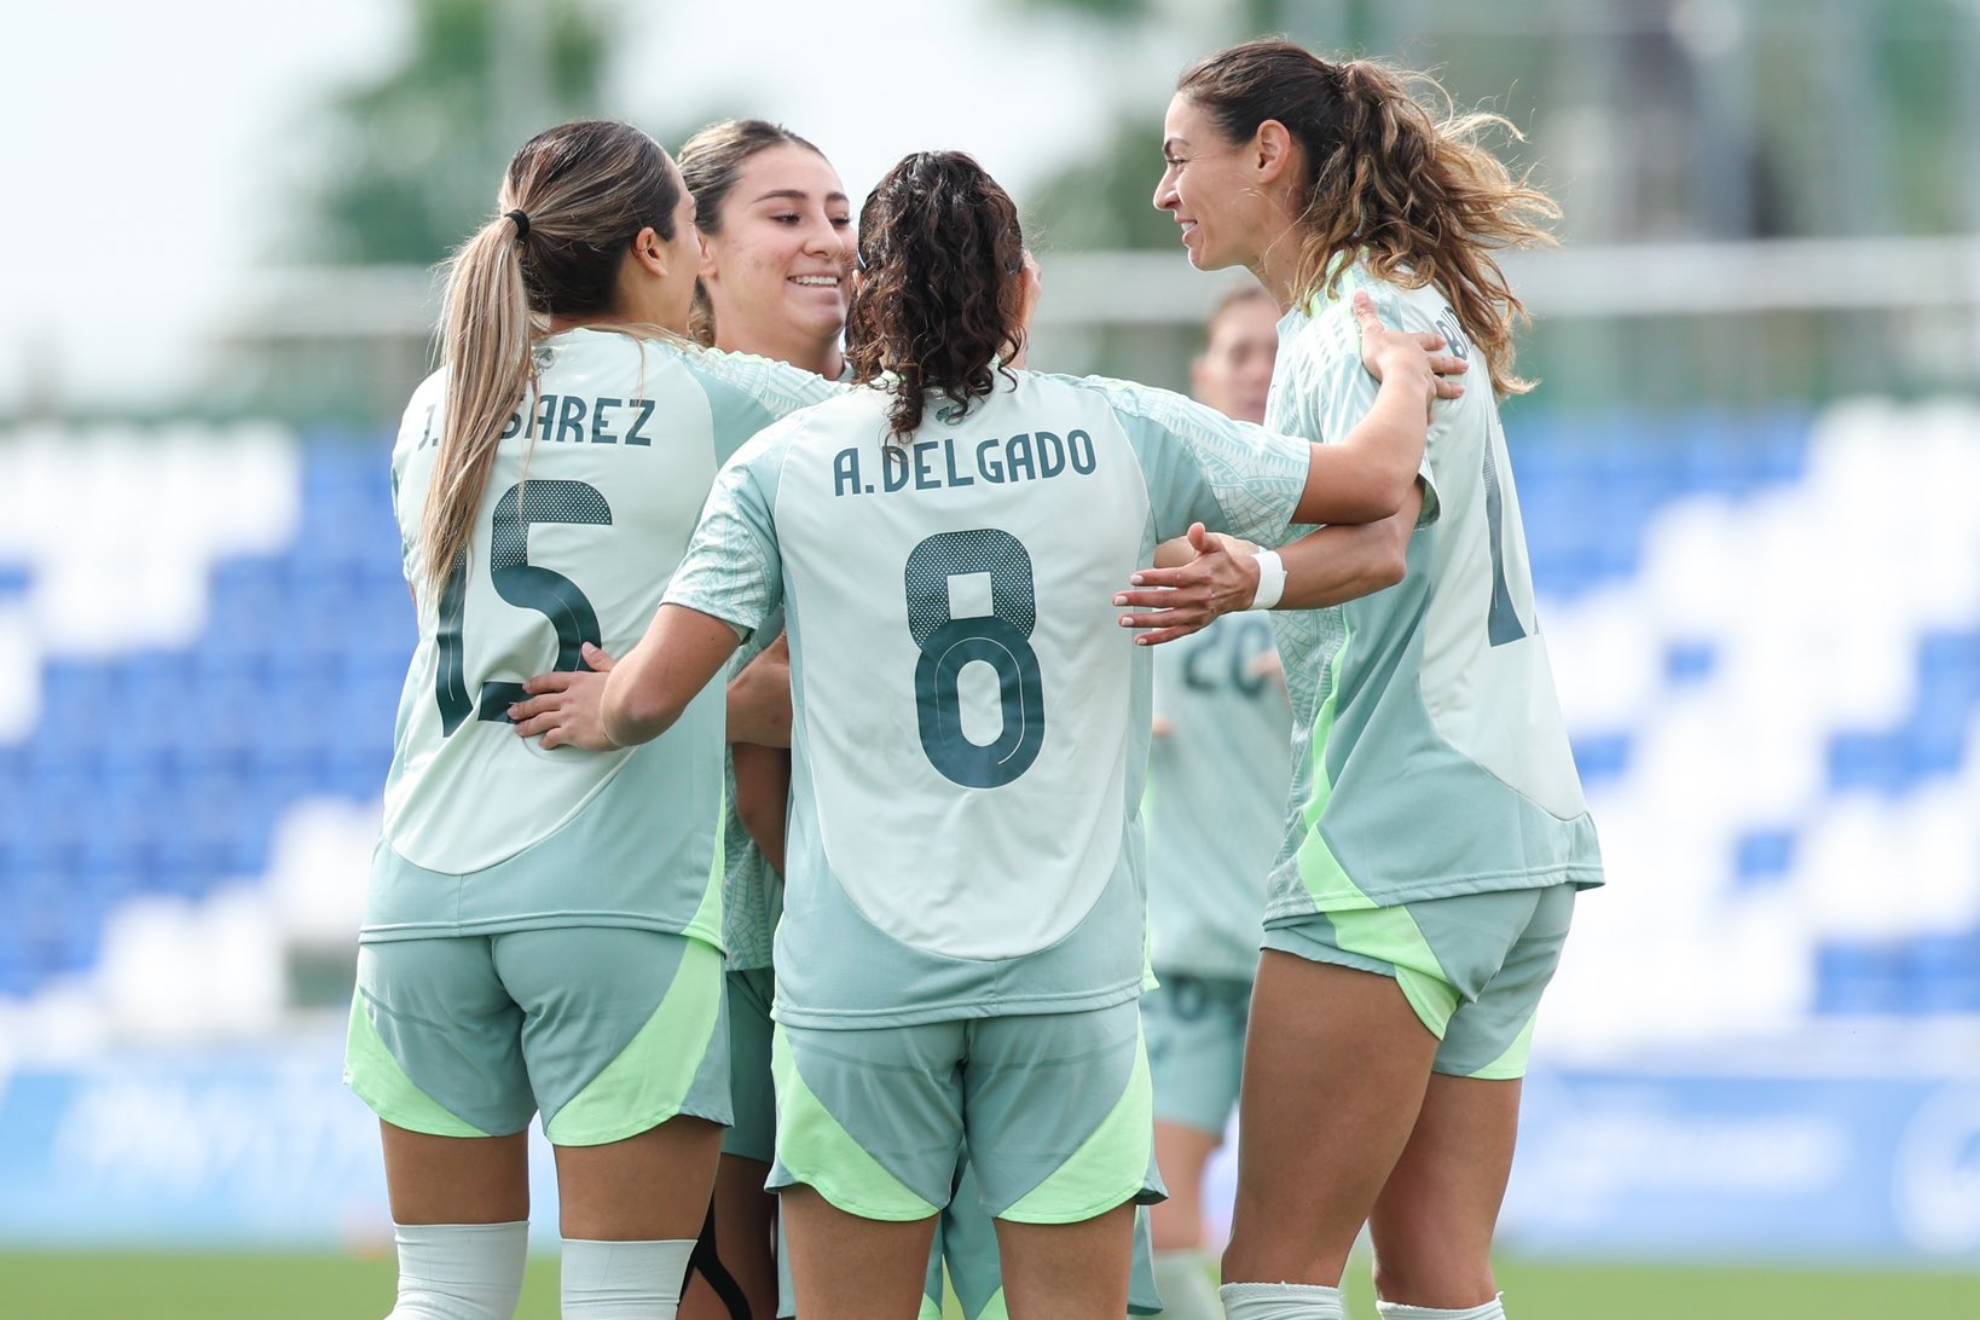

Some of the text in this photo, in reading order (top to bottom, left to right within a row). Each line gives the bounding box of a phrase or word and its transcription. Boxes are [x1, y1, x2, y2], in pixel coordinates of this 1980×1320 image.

[833, 429, 1096, 497] A.DELGADO
[435, 479, 612, 738] 15
[904, 528, 1045, 789] 8
